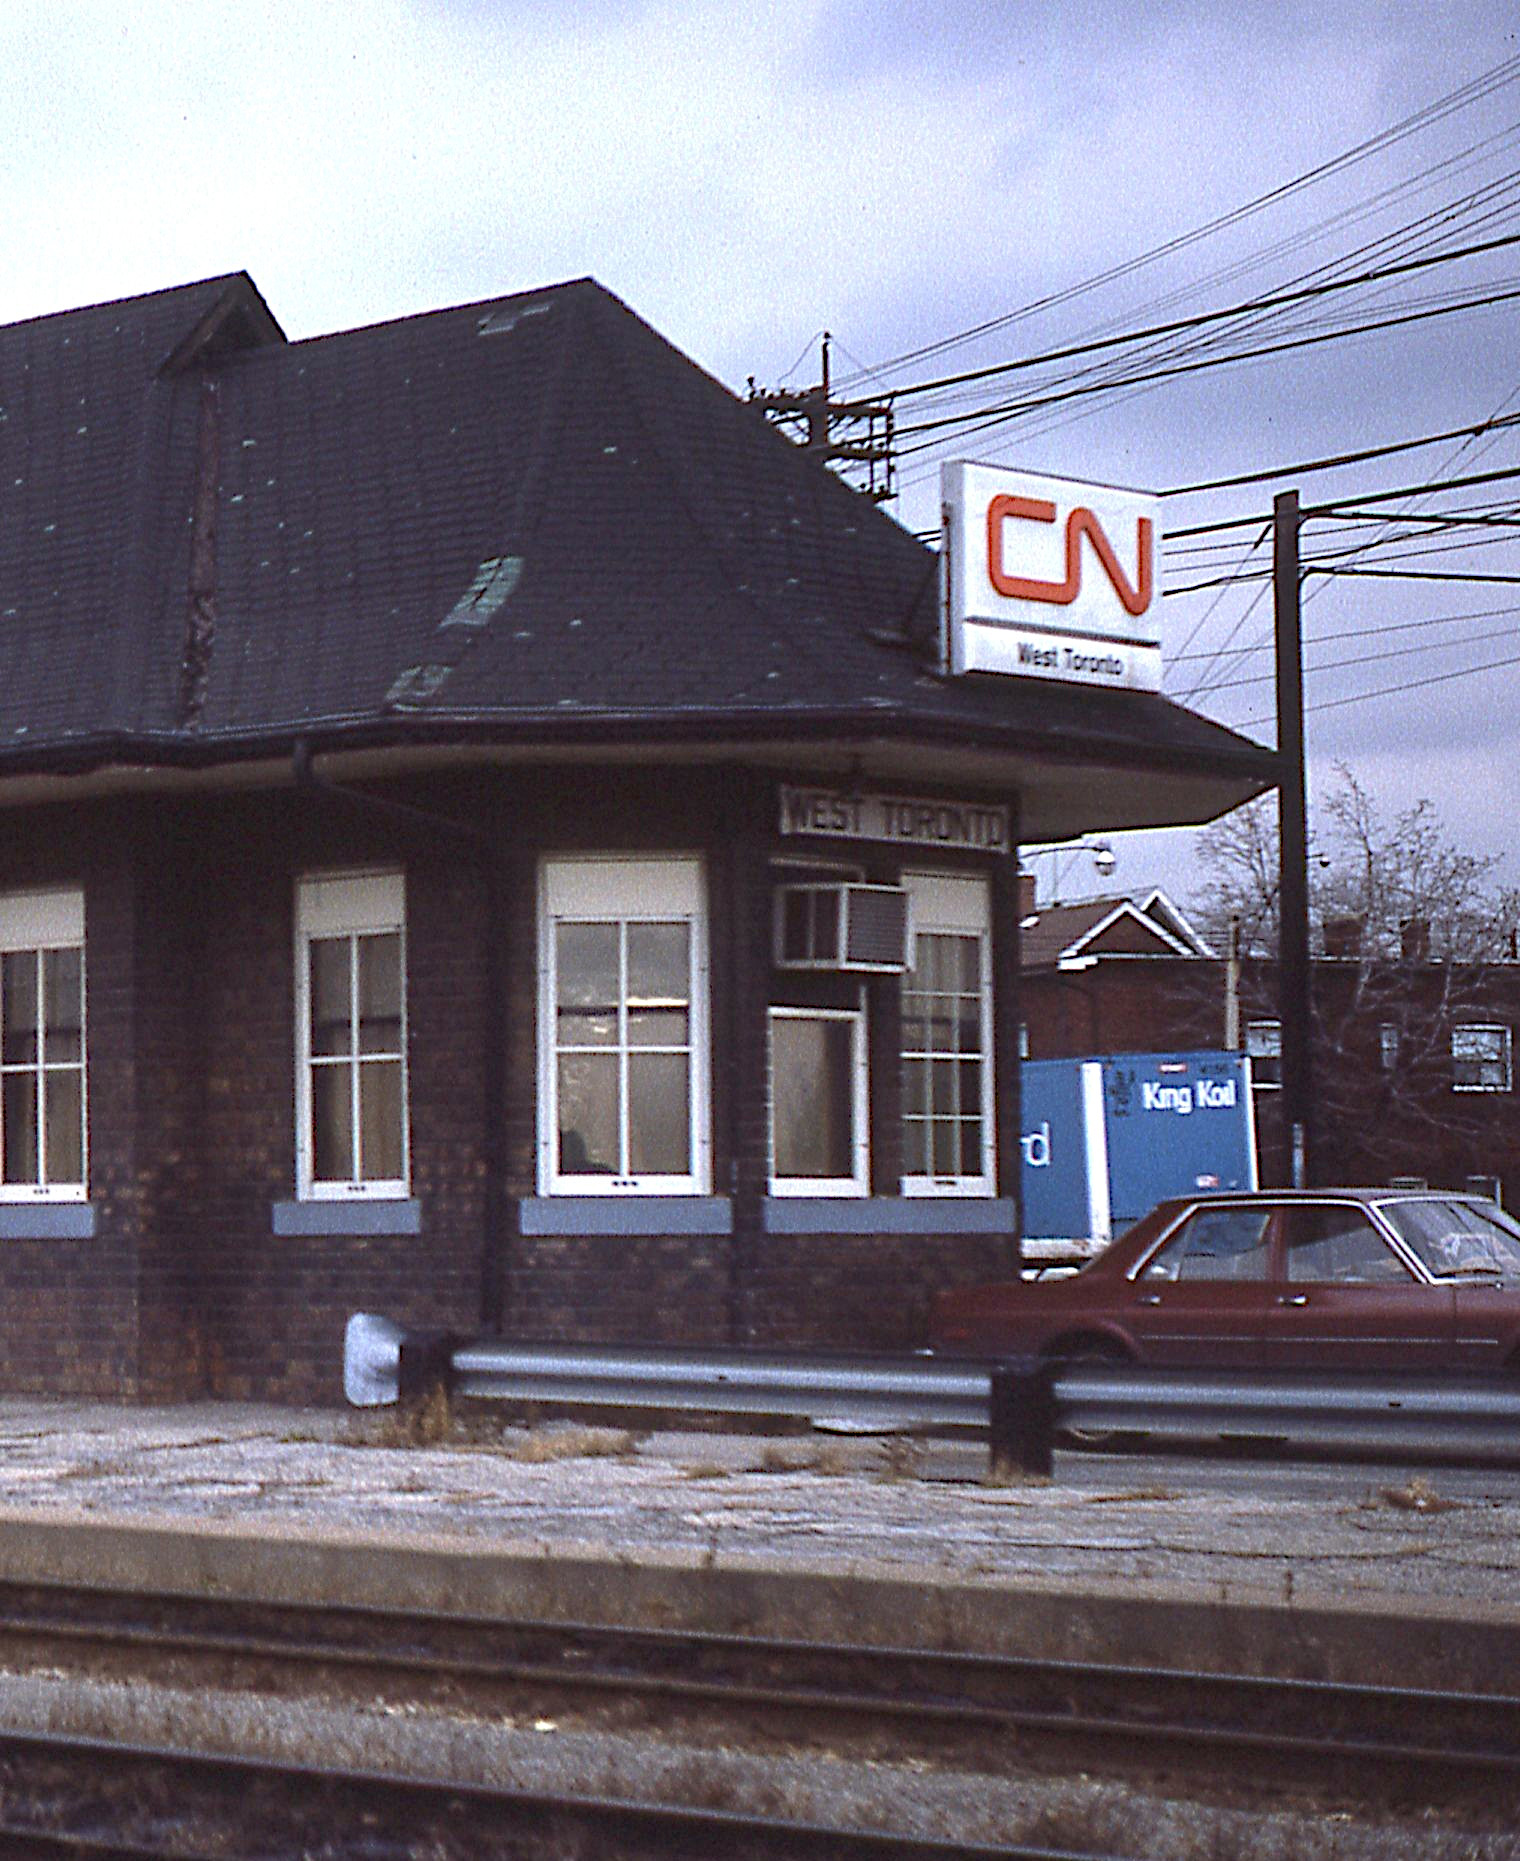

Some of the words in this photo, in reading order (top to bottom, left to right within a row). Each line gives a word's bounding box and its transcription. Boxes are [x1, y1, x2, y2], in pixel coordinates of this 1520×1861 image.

[987, 494, 1153, 616] CN
[1017, 642, 1057, 668] West
[1064, 647, 1124, 675] Toronto
[786, 792, 865, 833] WEST
[881, 801, 1005, 847] TORONTO
[1141, 1081, 1193, 1115] King
[1196, 1078, 1237, 1108] Koil
[1020, 1120, 1051, 1167] d
